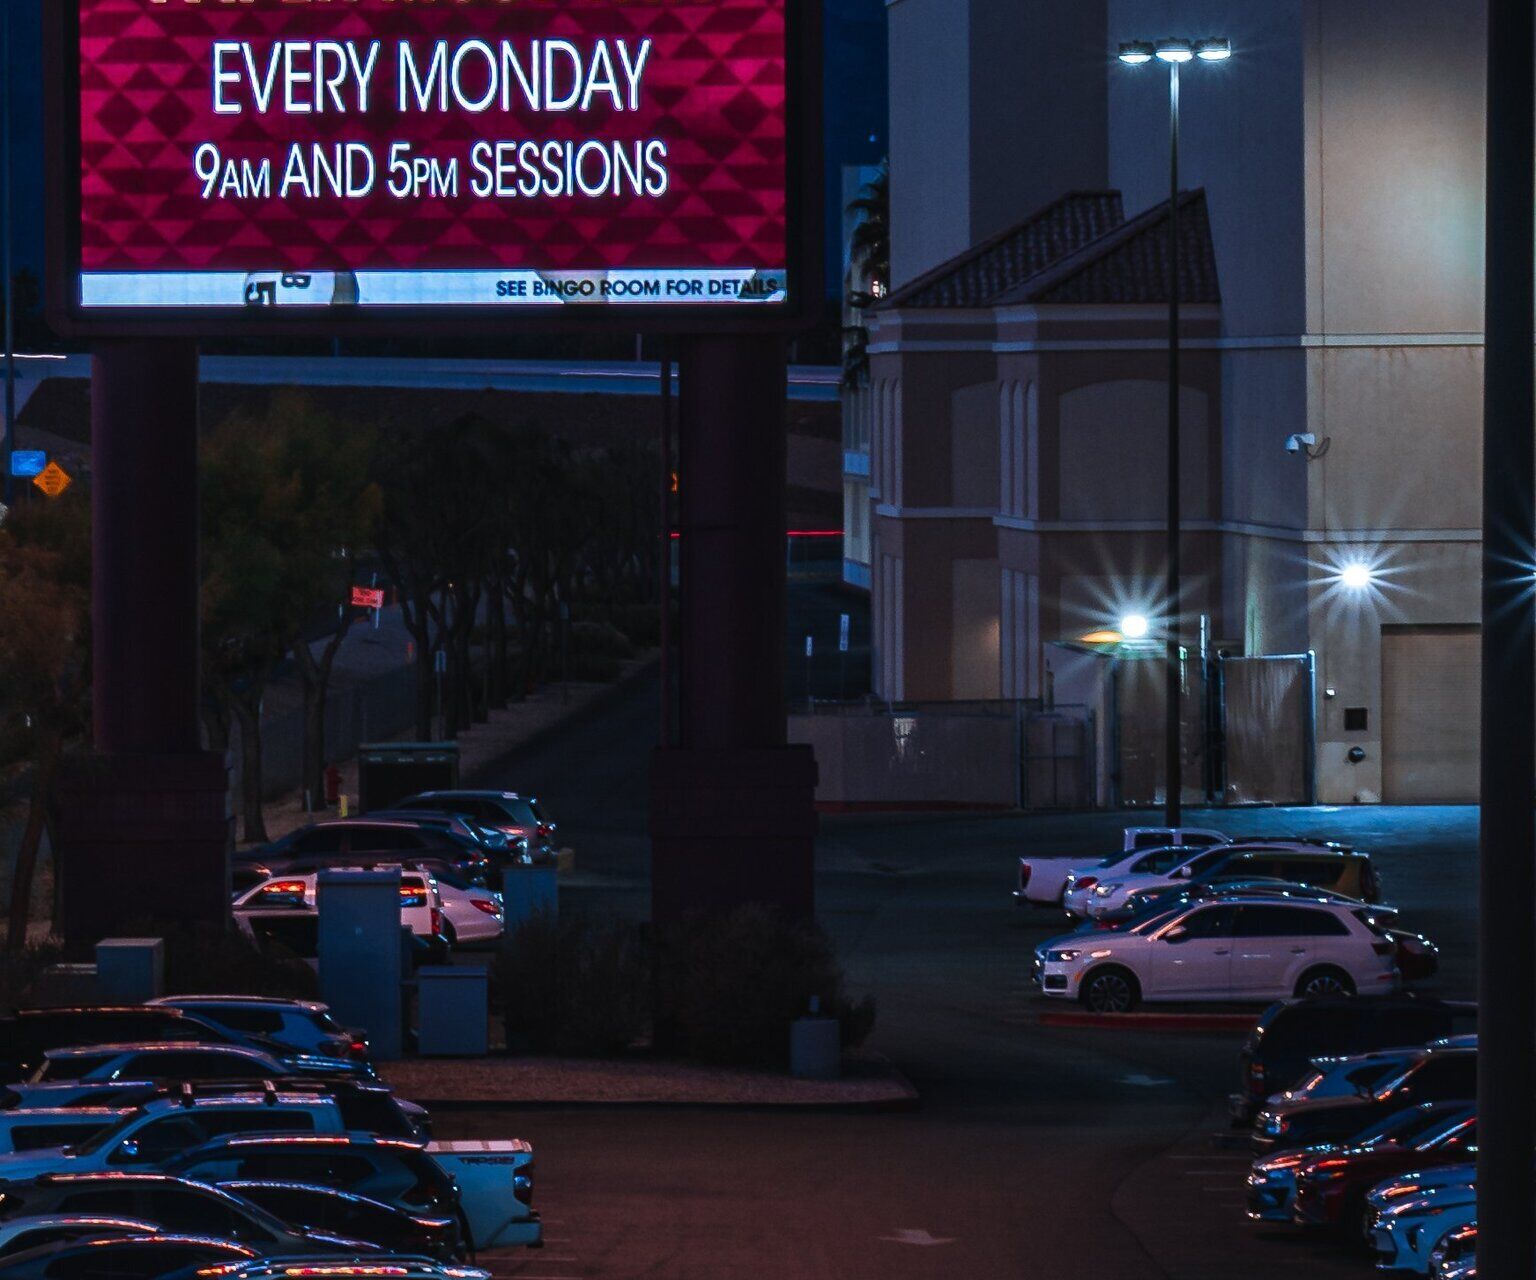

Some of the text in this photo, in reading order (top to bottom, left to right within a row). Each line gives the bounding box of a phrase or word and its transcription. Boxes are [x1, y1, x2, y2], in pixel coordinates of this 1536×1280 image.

[212, 38, 652, 114] EVERY MONDAY
[194, 140, 668, 199] 9AM AND 5PM SESSIONS
[496, 277, 778, 297] SEE BINGO ROOM FOR DETAILS
